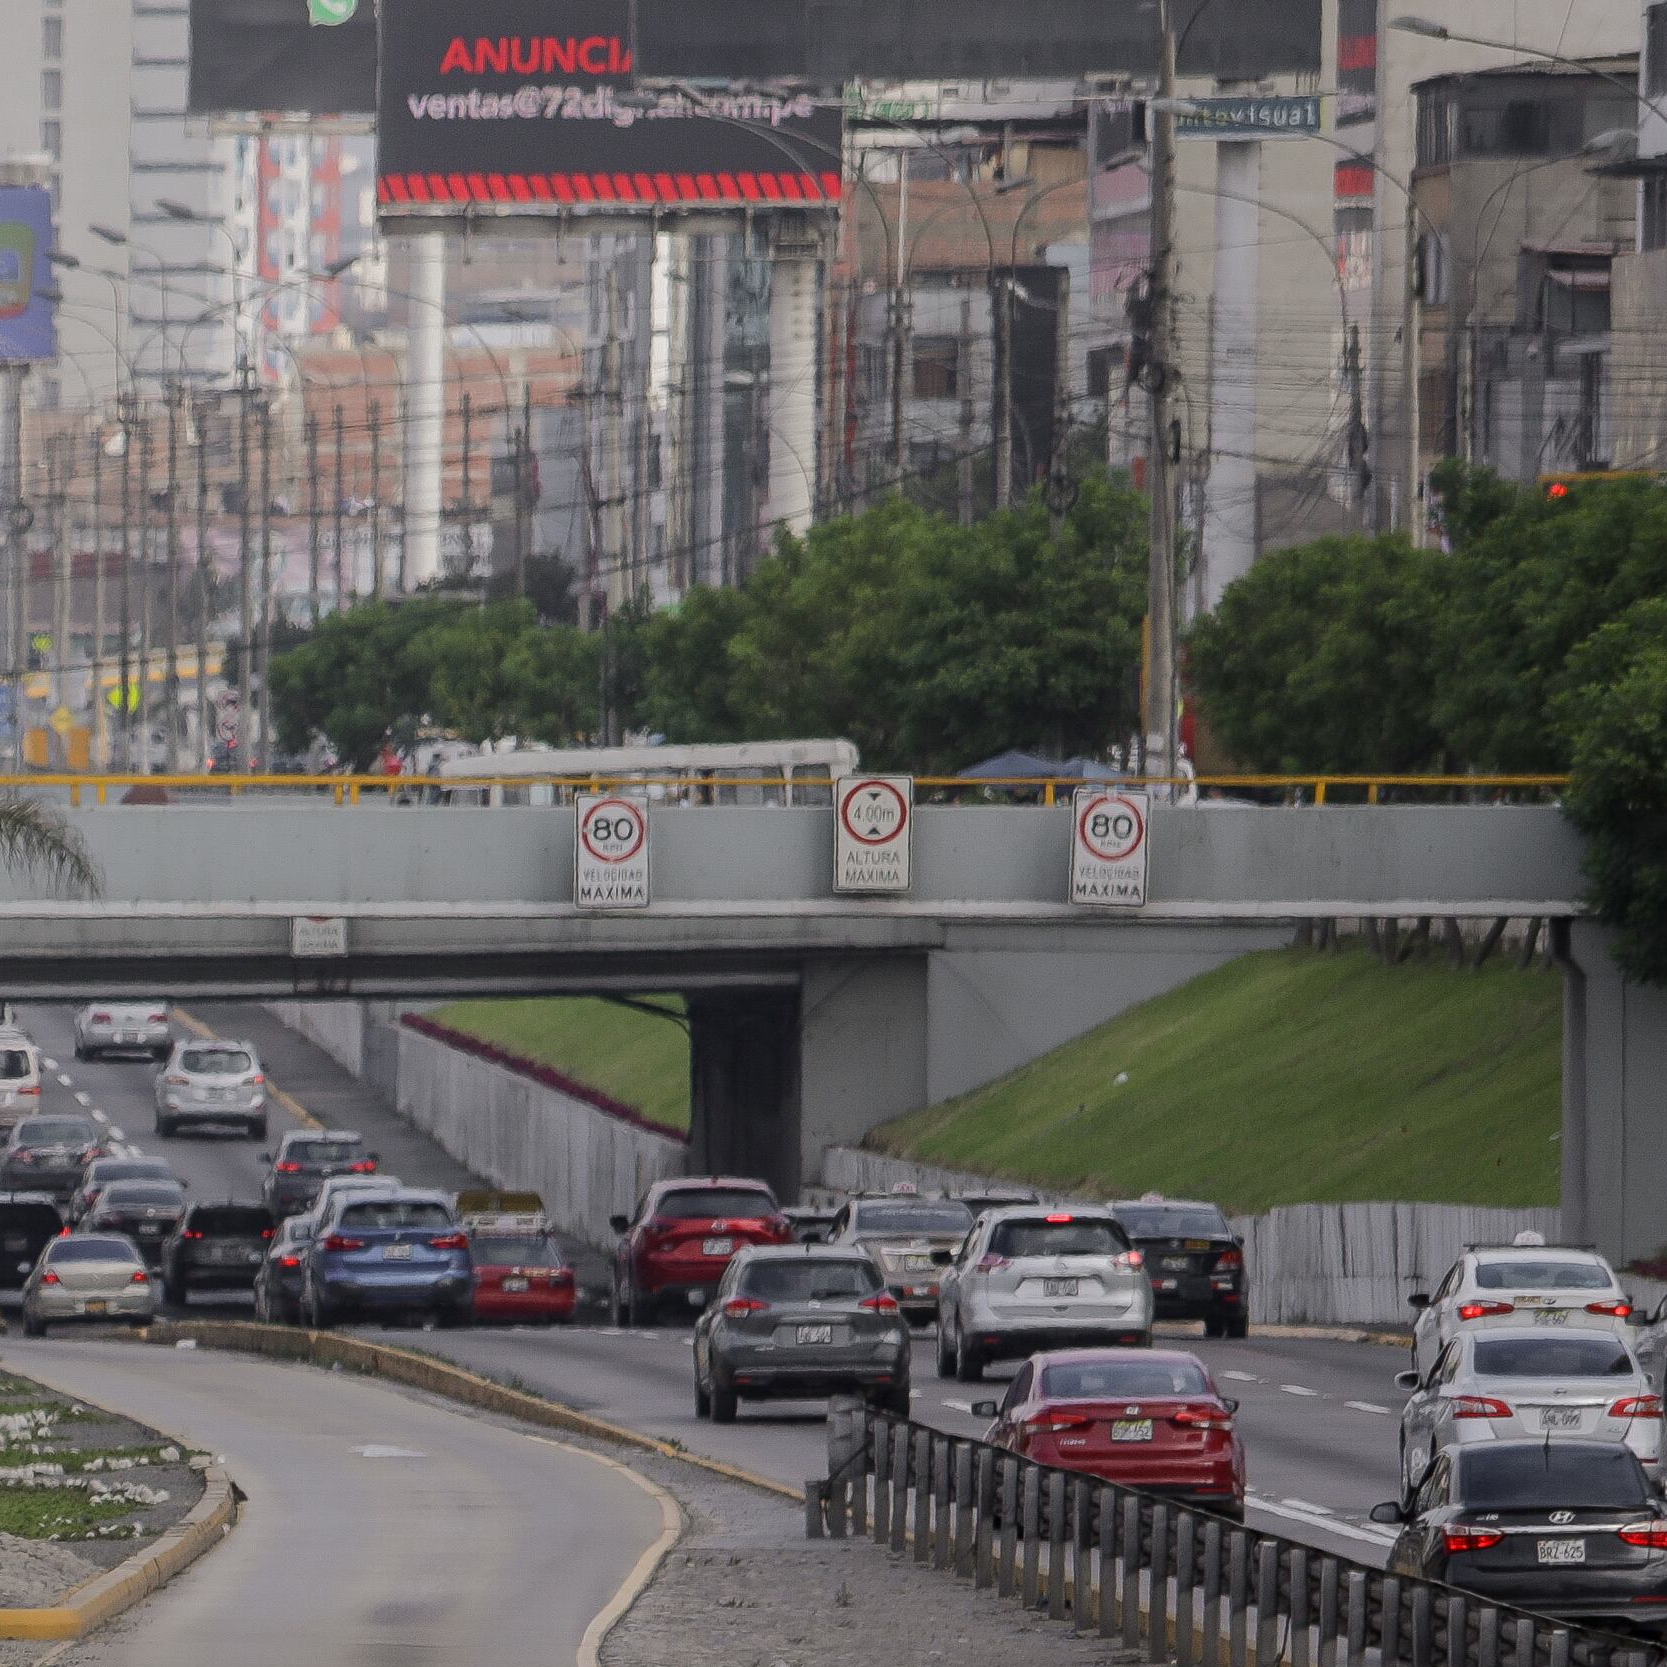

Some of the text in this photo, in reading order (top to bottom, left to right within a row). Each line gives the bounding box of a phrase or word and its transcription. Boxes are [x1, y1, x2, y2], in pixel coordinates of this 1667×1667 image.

[853, 804, 895, 823] 4.00m
[593, 818, 634, 840] 80
[1092, 814, 1133, 839] 80
[847, 850, 900, 866] ALTURA
[583, 867, 642, 882] VELOCIDAD
[1079, 864, 1139, 880] VELOCIDAD
